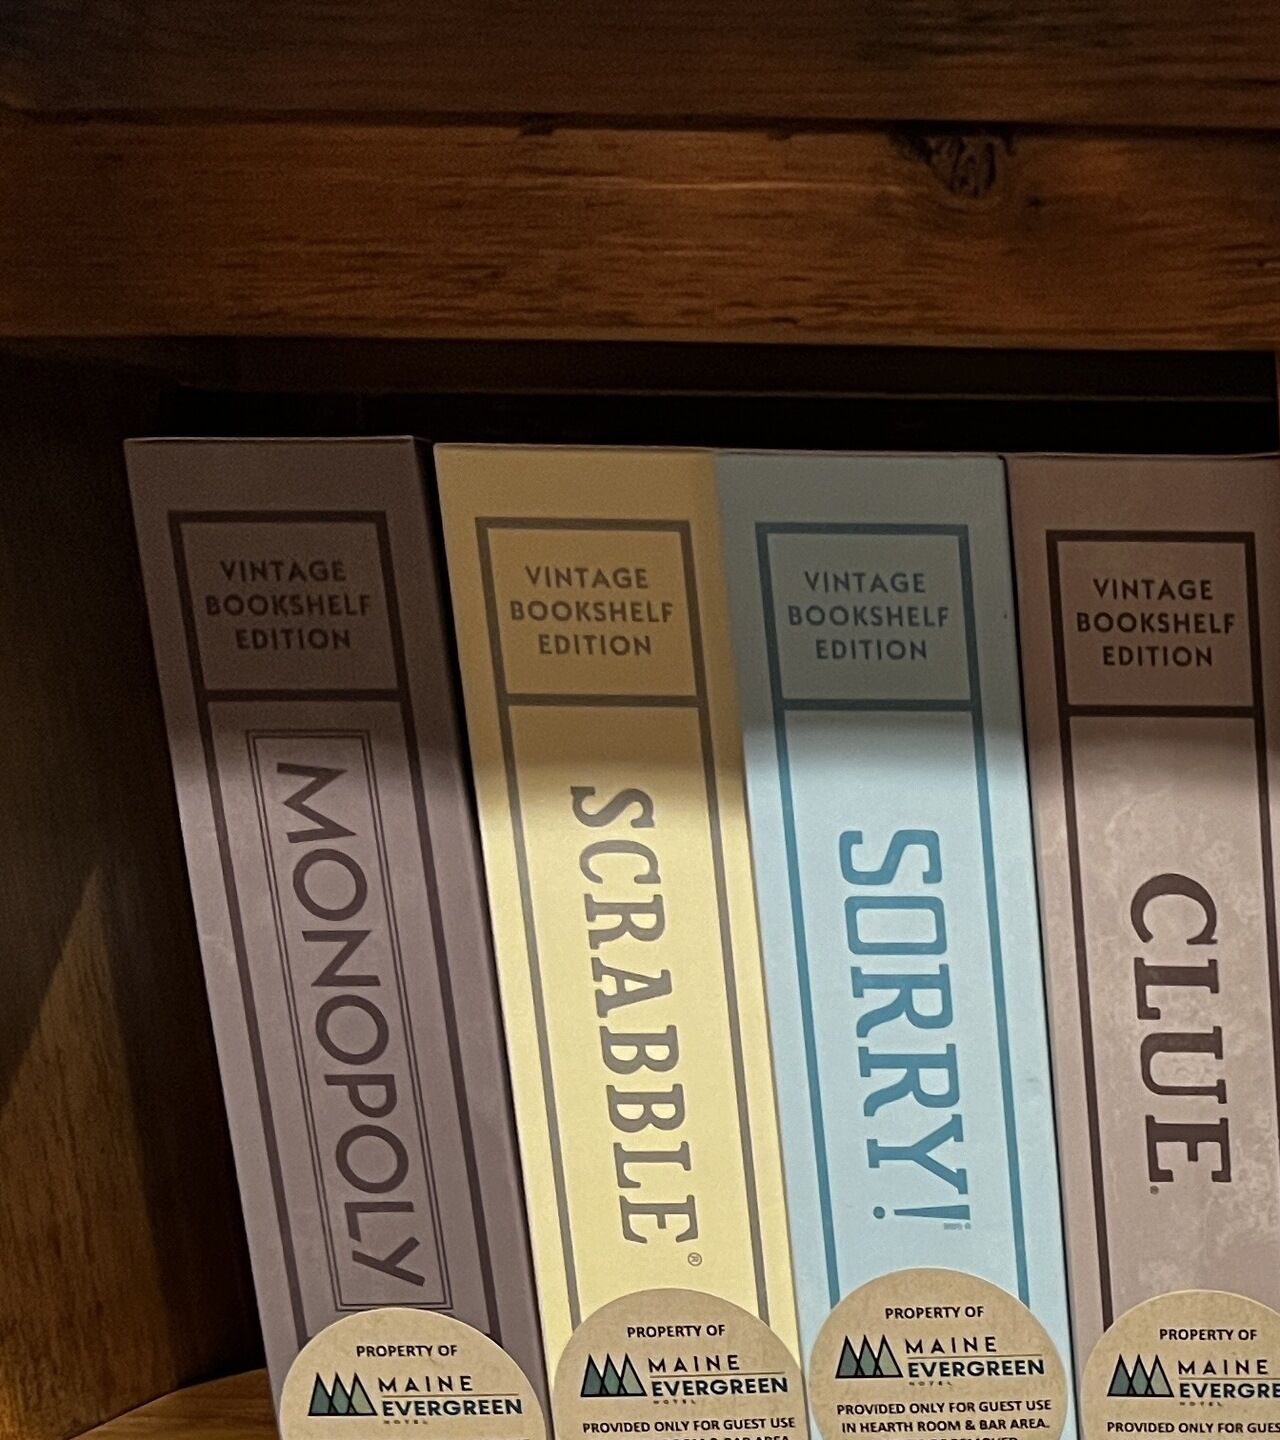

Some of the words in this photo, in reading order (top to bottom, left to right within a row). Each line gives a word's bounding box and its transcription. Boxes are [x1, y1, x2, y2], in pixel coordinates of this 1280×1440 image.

[219, 560, 346, 582] VINTAGE
[525, 566, 649, 589] VINTAGE
[804, 572, 926, 594] VINTAGE
[1093, 578, 1213, 601] VINTAGE
[205, 594, 371, 616] BOOKSHELF
[510, 601, 674, 622] BOOKSHELF
[788, 605, 949, 628] BOOKSHELF
[1076, 611, 1236, 635] BOOKSHELF
[235, 629, 351, 650] EDITION
[538, 634, 652, 656] EDITION
[815, 639, 928, 661] EDITION
[1102, 645, 1213, 667] EDITION
[276, 762, 426, 1287] MONOPOLY
[839, 829, 971, 1221] SORRY!
[1130, 873, 1232, 1183] CLUE
[885, 1306, 961, 1319] PROPERTY
[965, 1306, 984, 1317] OF
[627, 1325, 702, 1338] PROPERTY
[706, 1325, 726, 1336] OF
[1159, 1328, 1234, 1341] PROPERTY
[1238, 1328, 1258, 1340] OF
[356, 1345, 433, 1357] PROPERTY
[438, 1345, 458, 1356] OF
[905, 1336, 997, 1354] MAINE
[648, 1354, 740, 1373] MAINE
[908, 1359, 1044, 1378] EVERGREEN
[1178, 1359, 1268, 1375] MAINE
[378, 1375, 473, 1392] MAINE
[651, 1377, 788, 1397] EVERGREEN
[382, 1399, 522, 1416] EVERGREEN
